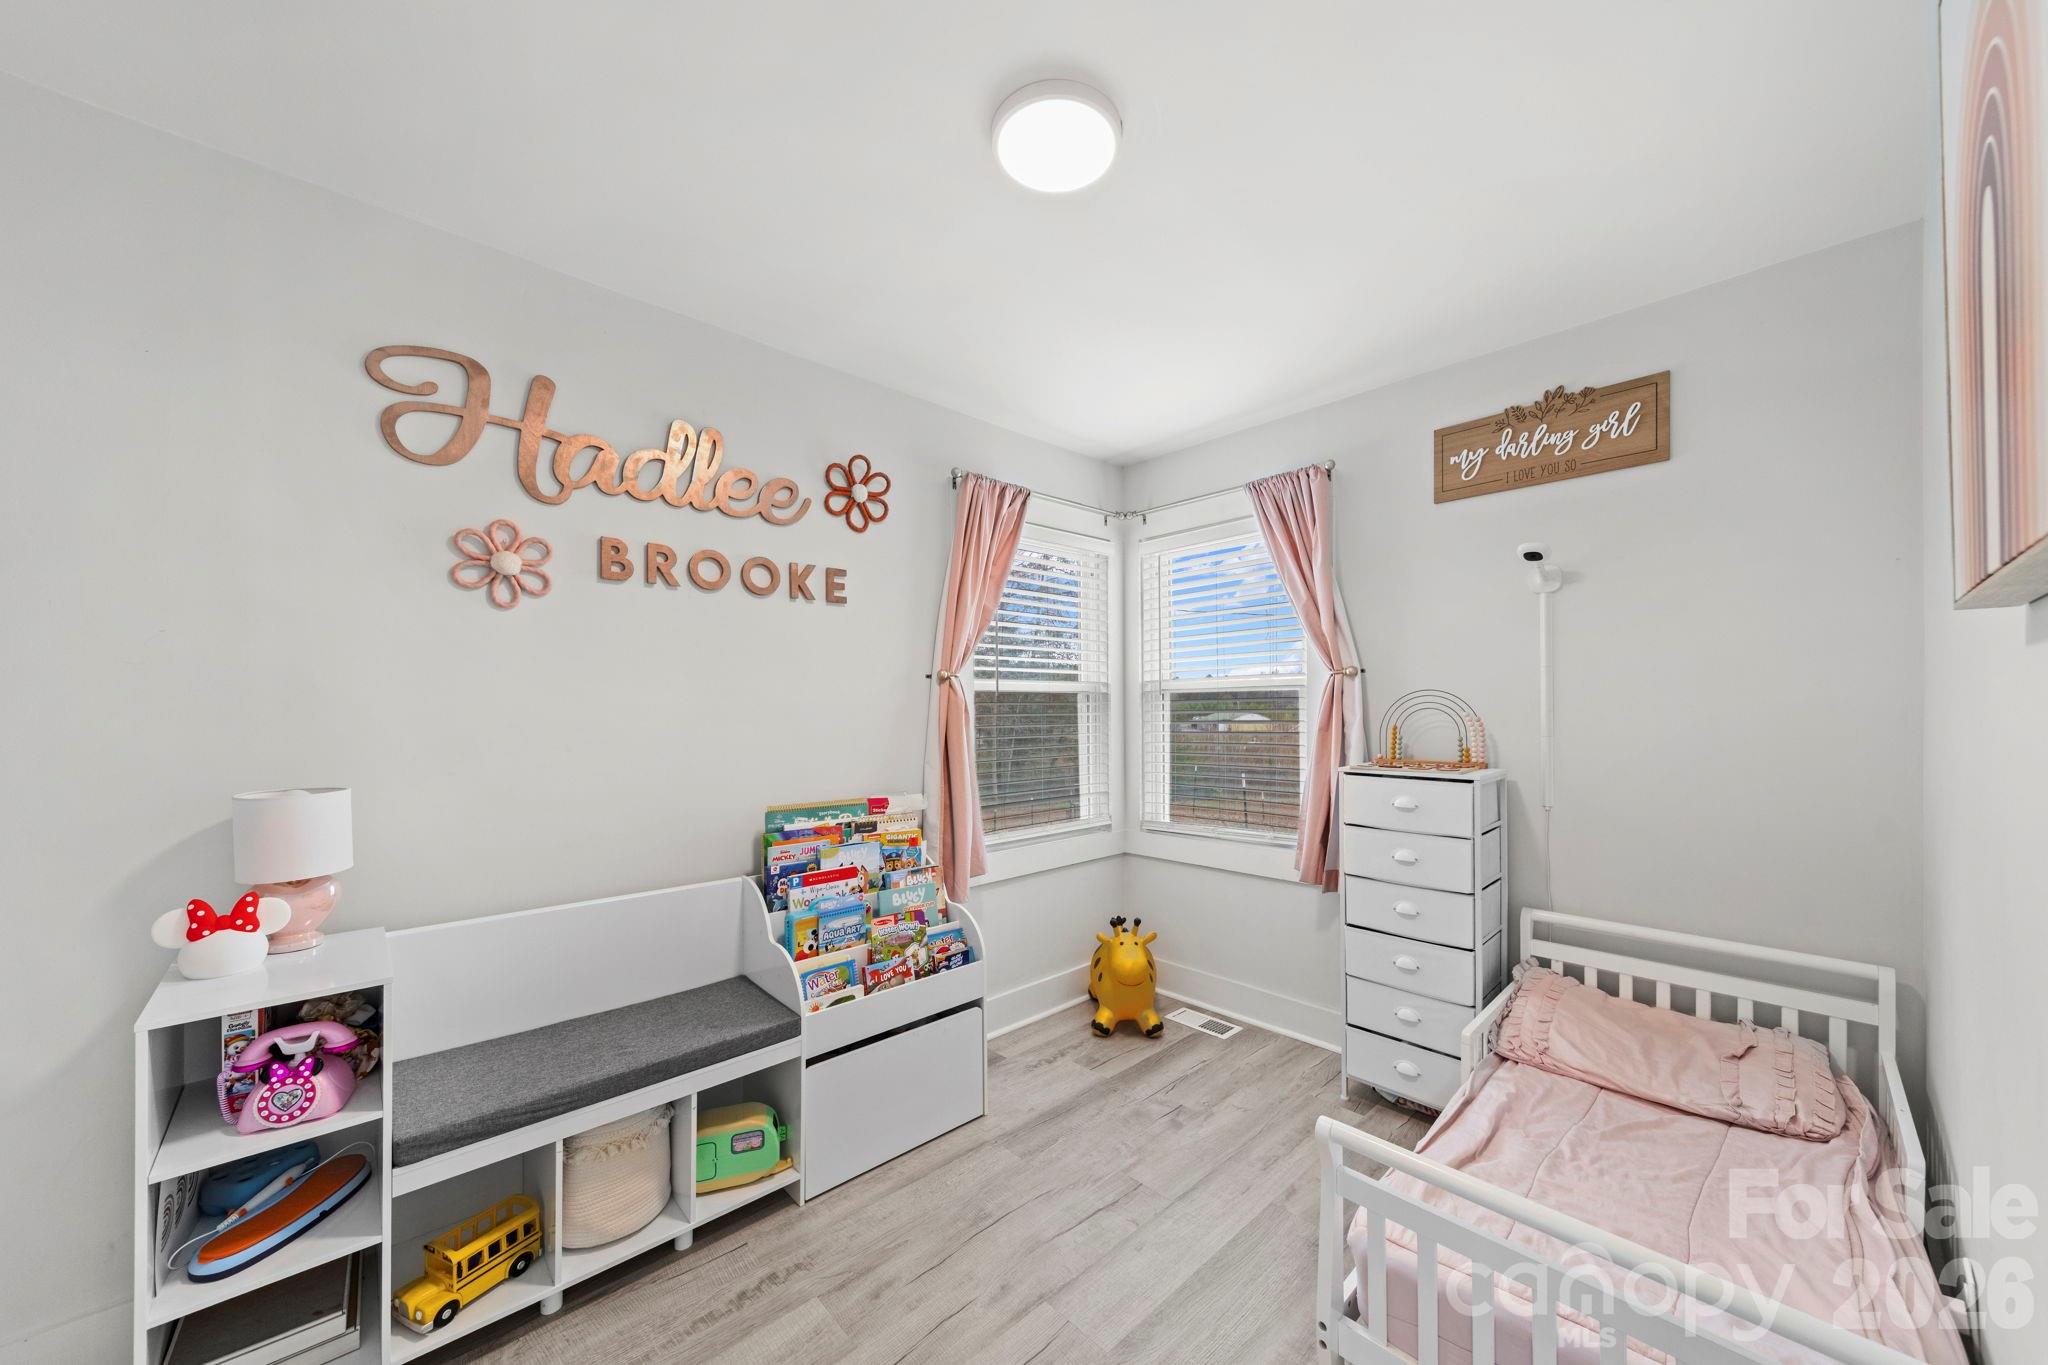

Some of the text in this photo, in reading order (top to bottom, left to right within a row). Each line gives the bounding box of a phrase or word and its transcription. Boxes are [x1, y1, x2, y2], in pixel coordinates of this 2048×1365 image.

[365, 345, 811, 525] Hadlee
[1450, 401, 1641, 480] my darling girl
[1513, 466, 1535, 483] LOVE
[1540, 462, 1559, 479] YOU
[1564, 459, 1576, 472] SO
[599, 536, 847, 604] BROOKE
[793, 878, 799, 886] P
[846, 924, 862, 935] ART
[898, 921, 919, 932] WOW!
[808, 970, 839, 990] Water
[880, 970, 894, 982] LOVE
[895, 965, 907, 974] YOU
